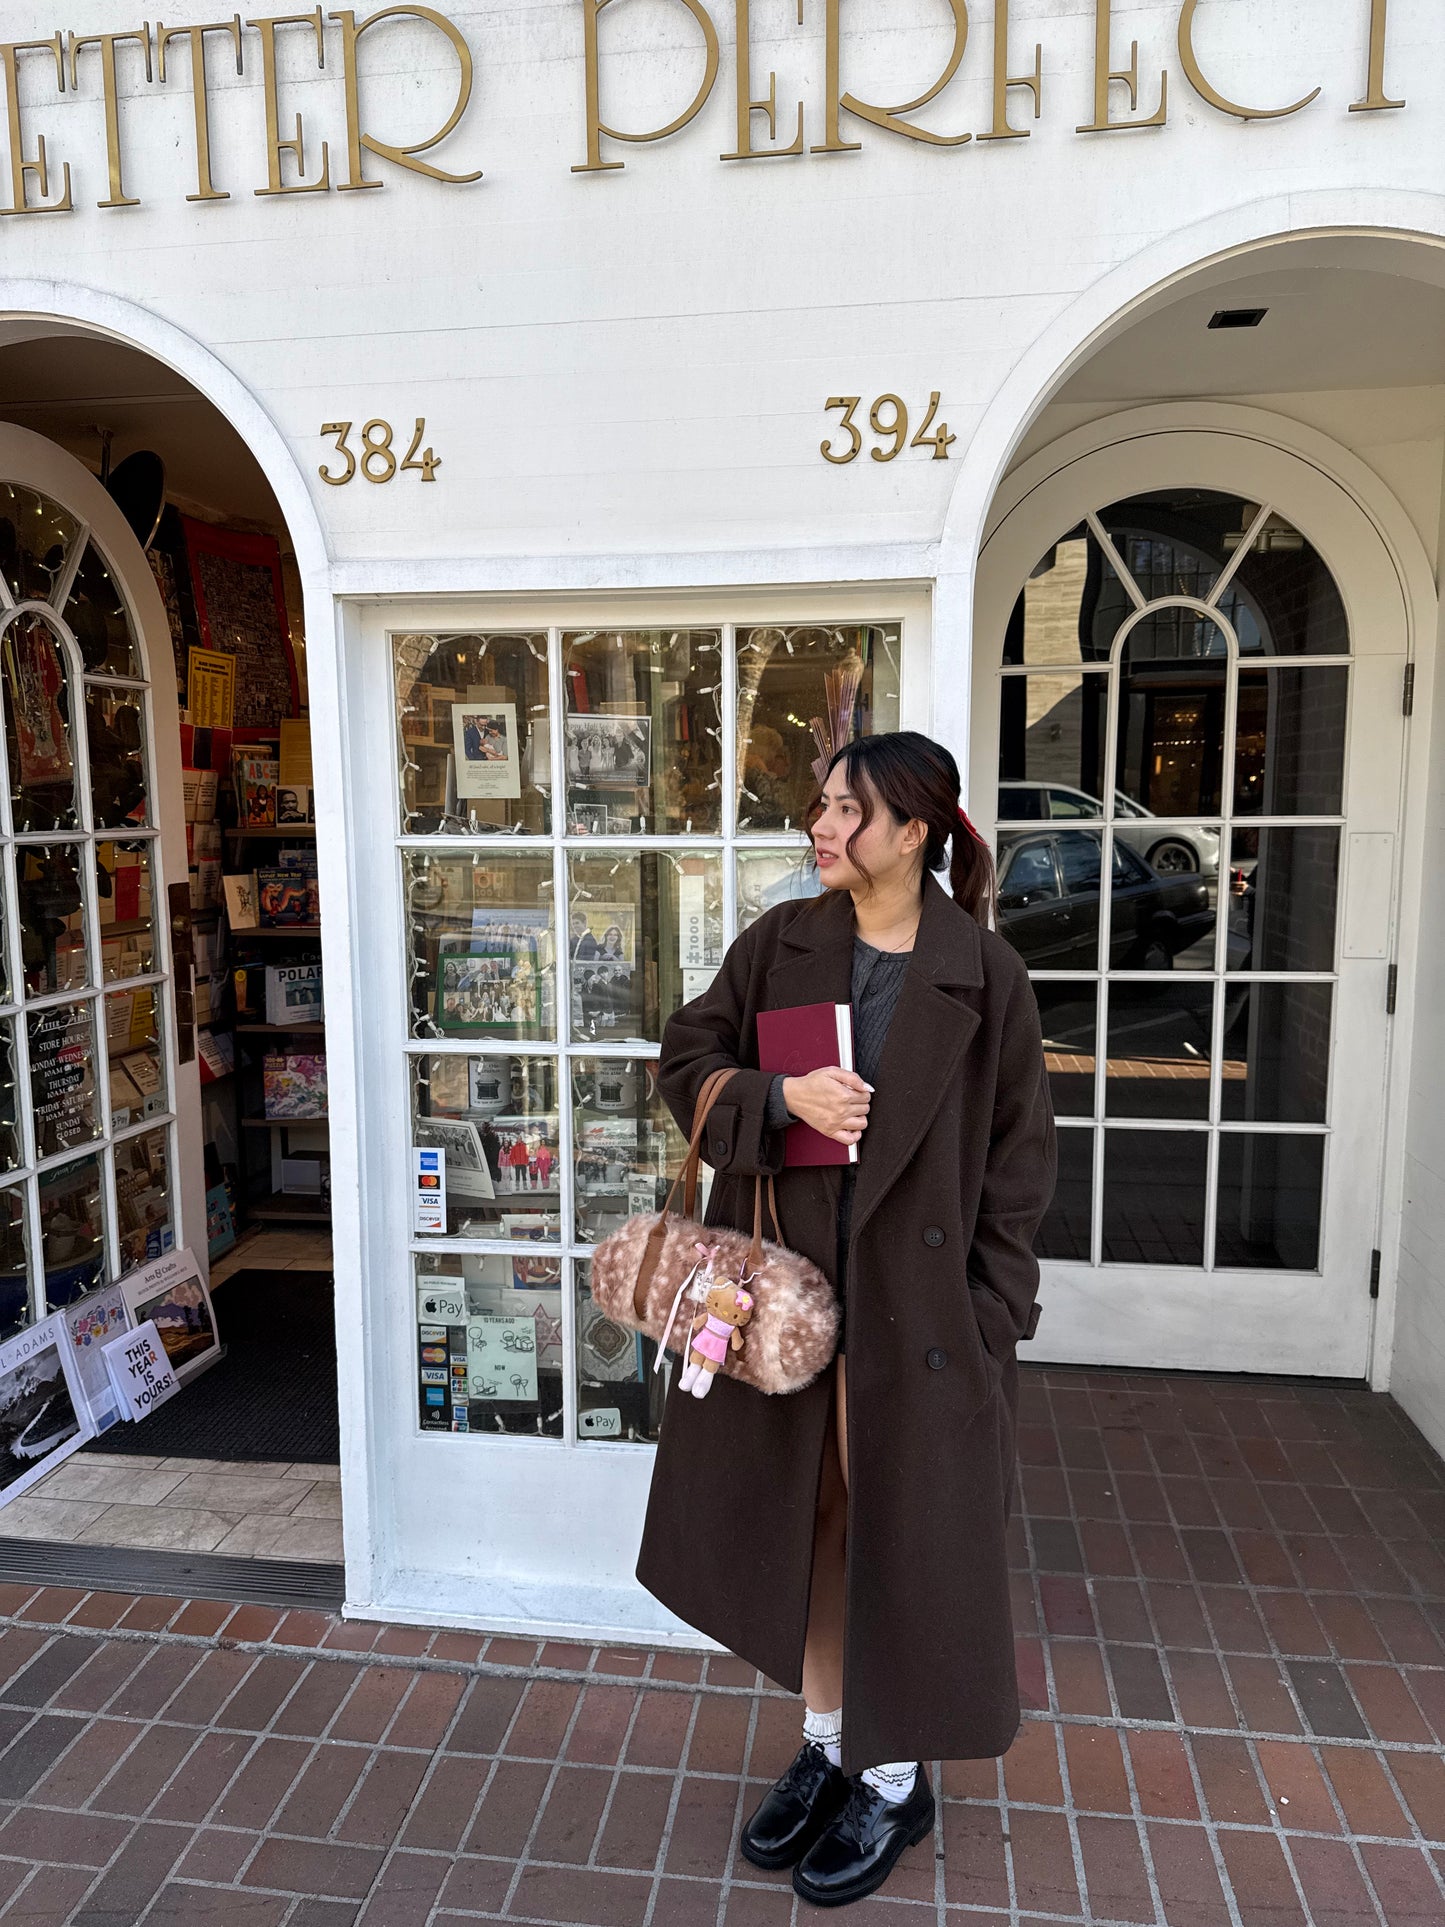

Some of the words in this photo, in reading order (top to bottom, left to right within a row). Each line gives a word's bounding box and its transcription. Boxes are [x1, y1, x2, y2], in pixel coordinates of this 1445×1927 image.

[820, 390, 957, 465] 394
[318, 416, 442, 485] 384
[248, 763, 271, 780] ABC
[690, 916, 699, 950] 1000
[38, 1038, 60, 1052] STORE
[61, 1032, 85, 1046] HOURS
[48, 1073, 80, 1090] THURSDAY
[55, 1115, 81, 1132] SUNDAY
[56, 1126, 81, 1140] CLOSED
[421, 1197, 439, 1205] VISA
[144, 1273, 156, 1284] Arts
[161, 1262, 177, 1274] Crafts
[439, 1299, 463, 1317] Pay
[16, 1327, 55, 1361] ADAMS
[125, 1339, 151, 1363] THIS
[128, 1350, 158, 1379] YEAR
[143, 1370, 155, 1387] IS
[425, 1371, 445, 1380] VISA
[134, 1372, 174, 1409] YOURS!
[595, 1415, 616, 1430] Pay
